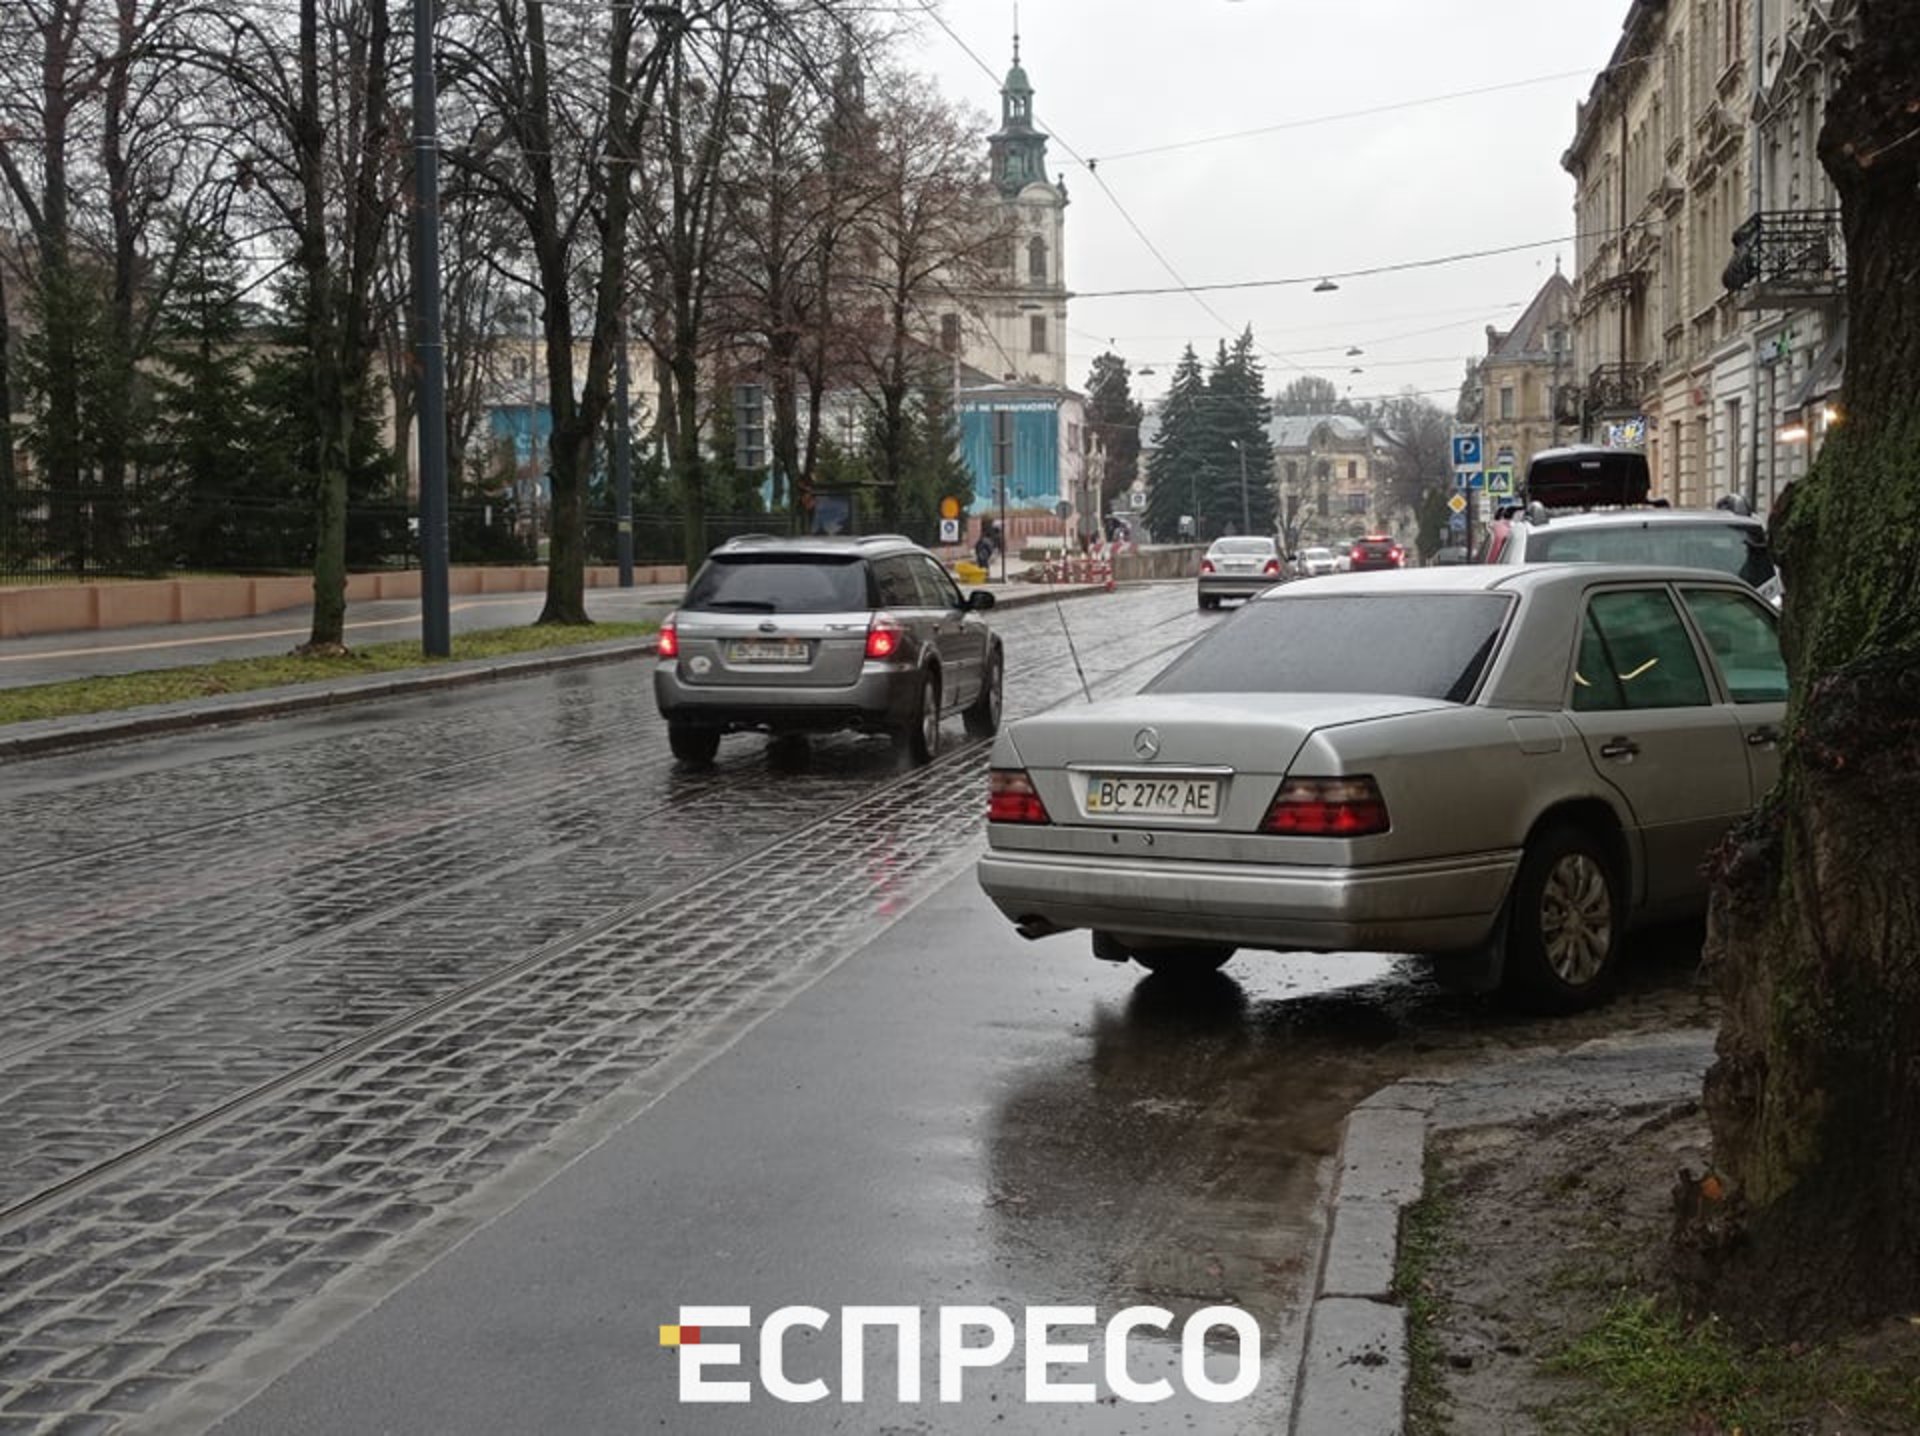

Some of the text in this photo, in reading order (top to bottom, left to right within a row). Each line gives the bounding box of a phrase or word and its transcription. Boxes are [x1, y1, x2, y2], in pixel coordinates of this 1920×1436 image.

[1459, 439, 1476, 462] P
[1100, 782, 1211, 809] BC 2762 AE
